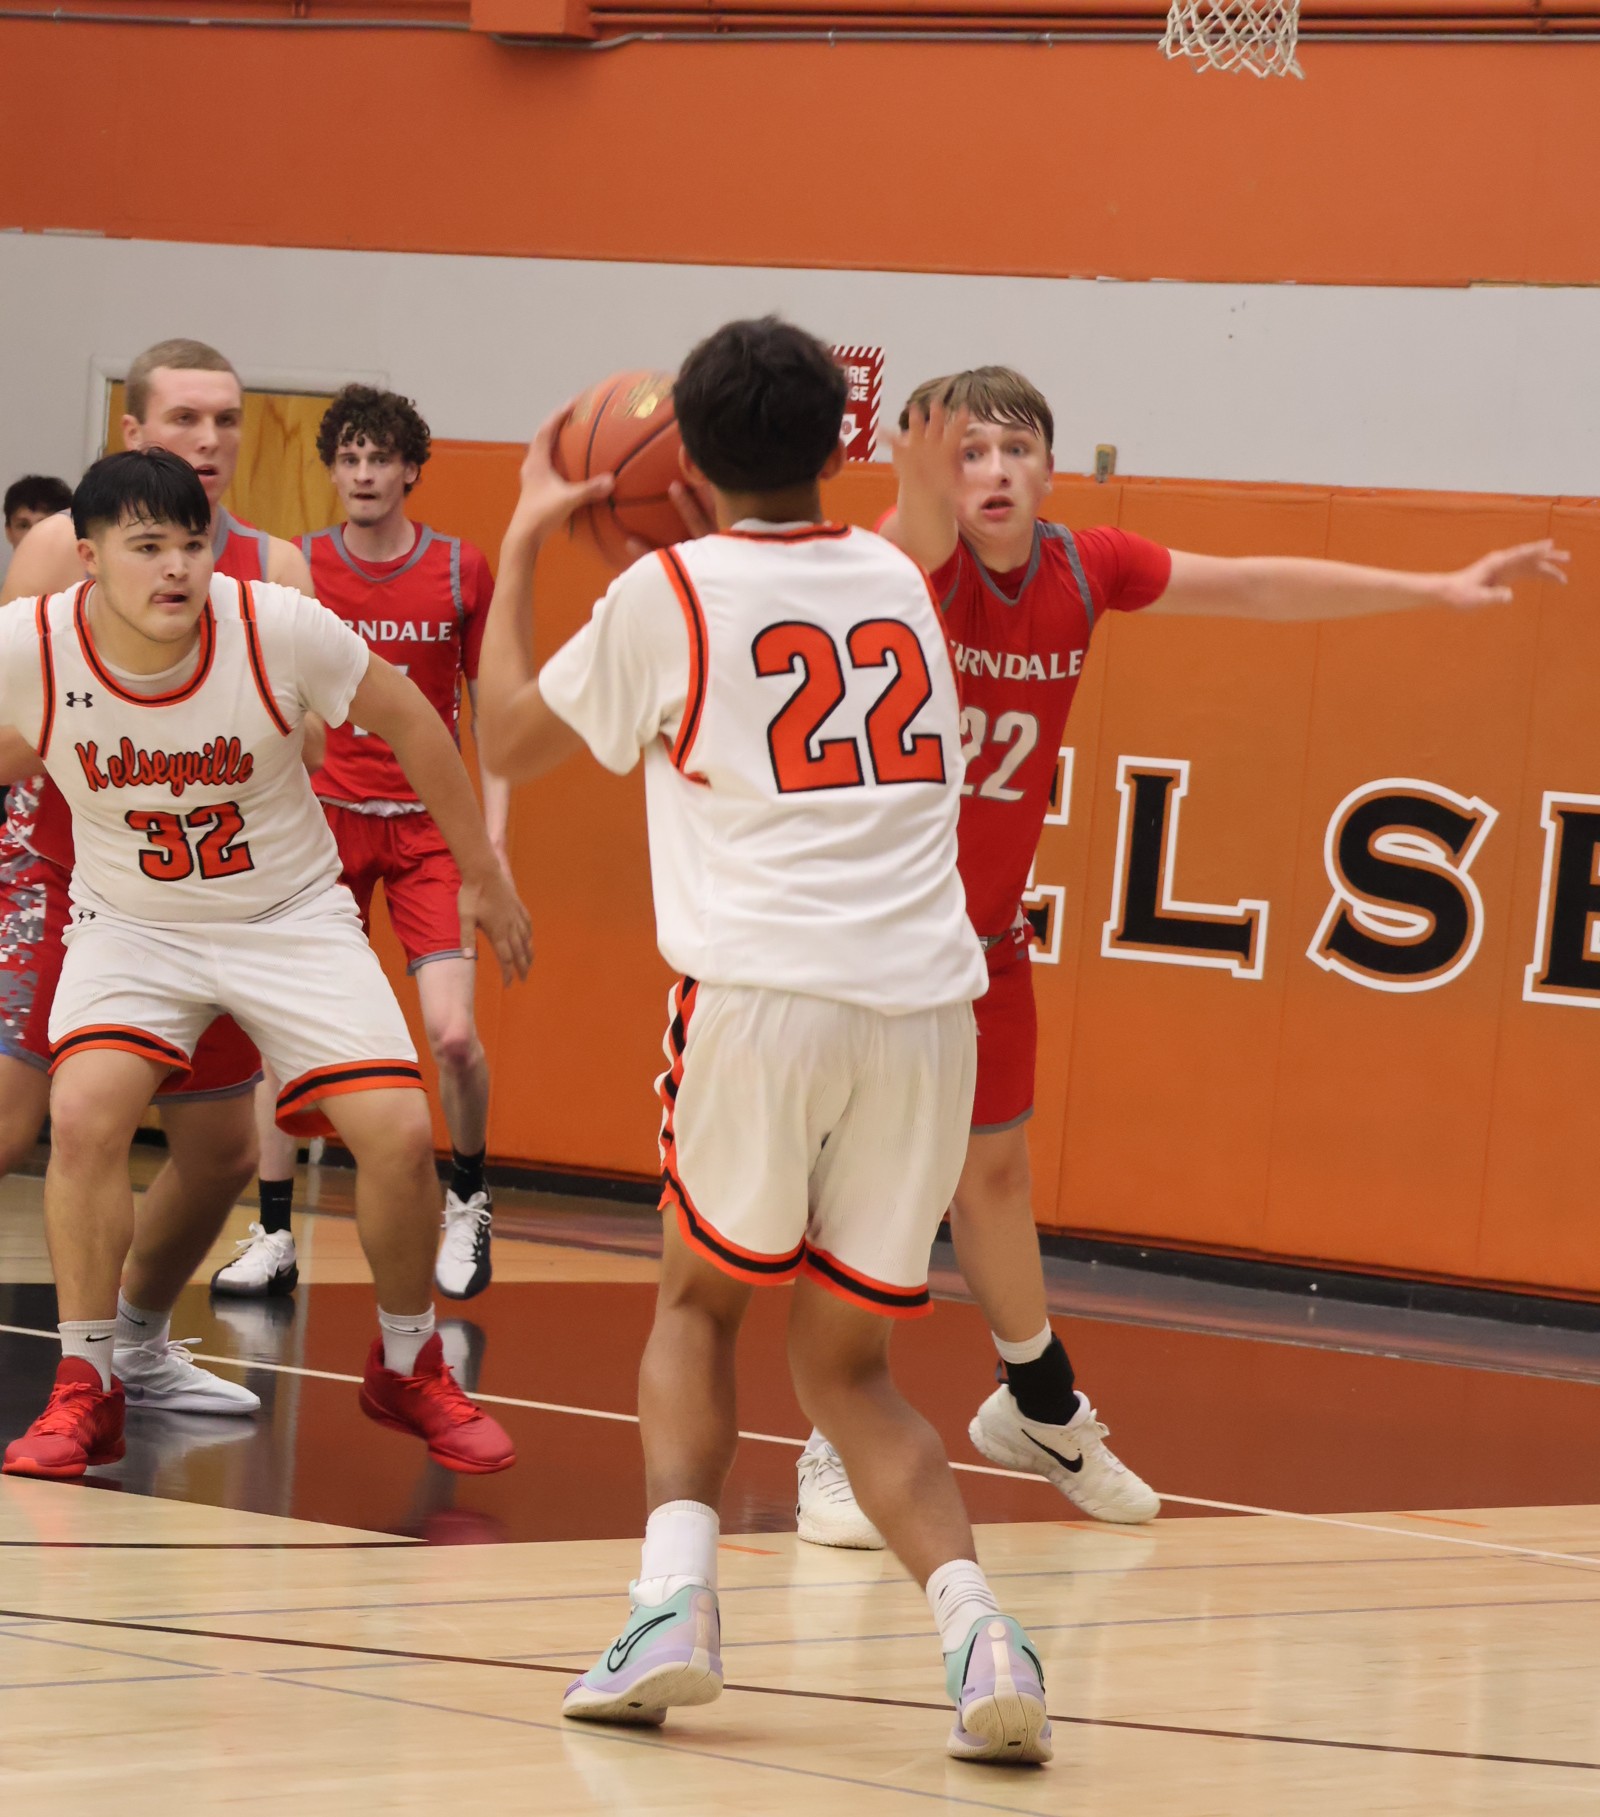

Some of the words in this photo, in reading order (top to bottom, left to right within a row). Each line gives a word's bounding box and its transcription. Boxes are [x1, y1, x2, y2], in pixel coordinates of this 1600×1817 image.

[751, 618, 947, 794] 22
[75, 735, 254, 797] Kelseyville
[960, 706, 1039, 802] 22
[124, 801, 255, 882] 32
